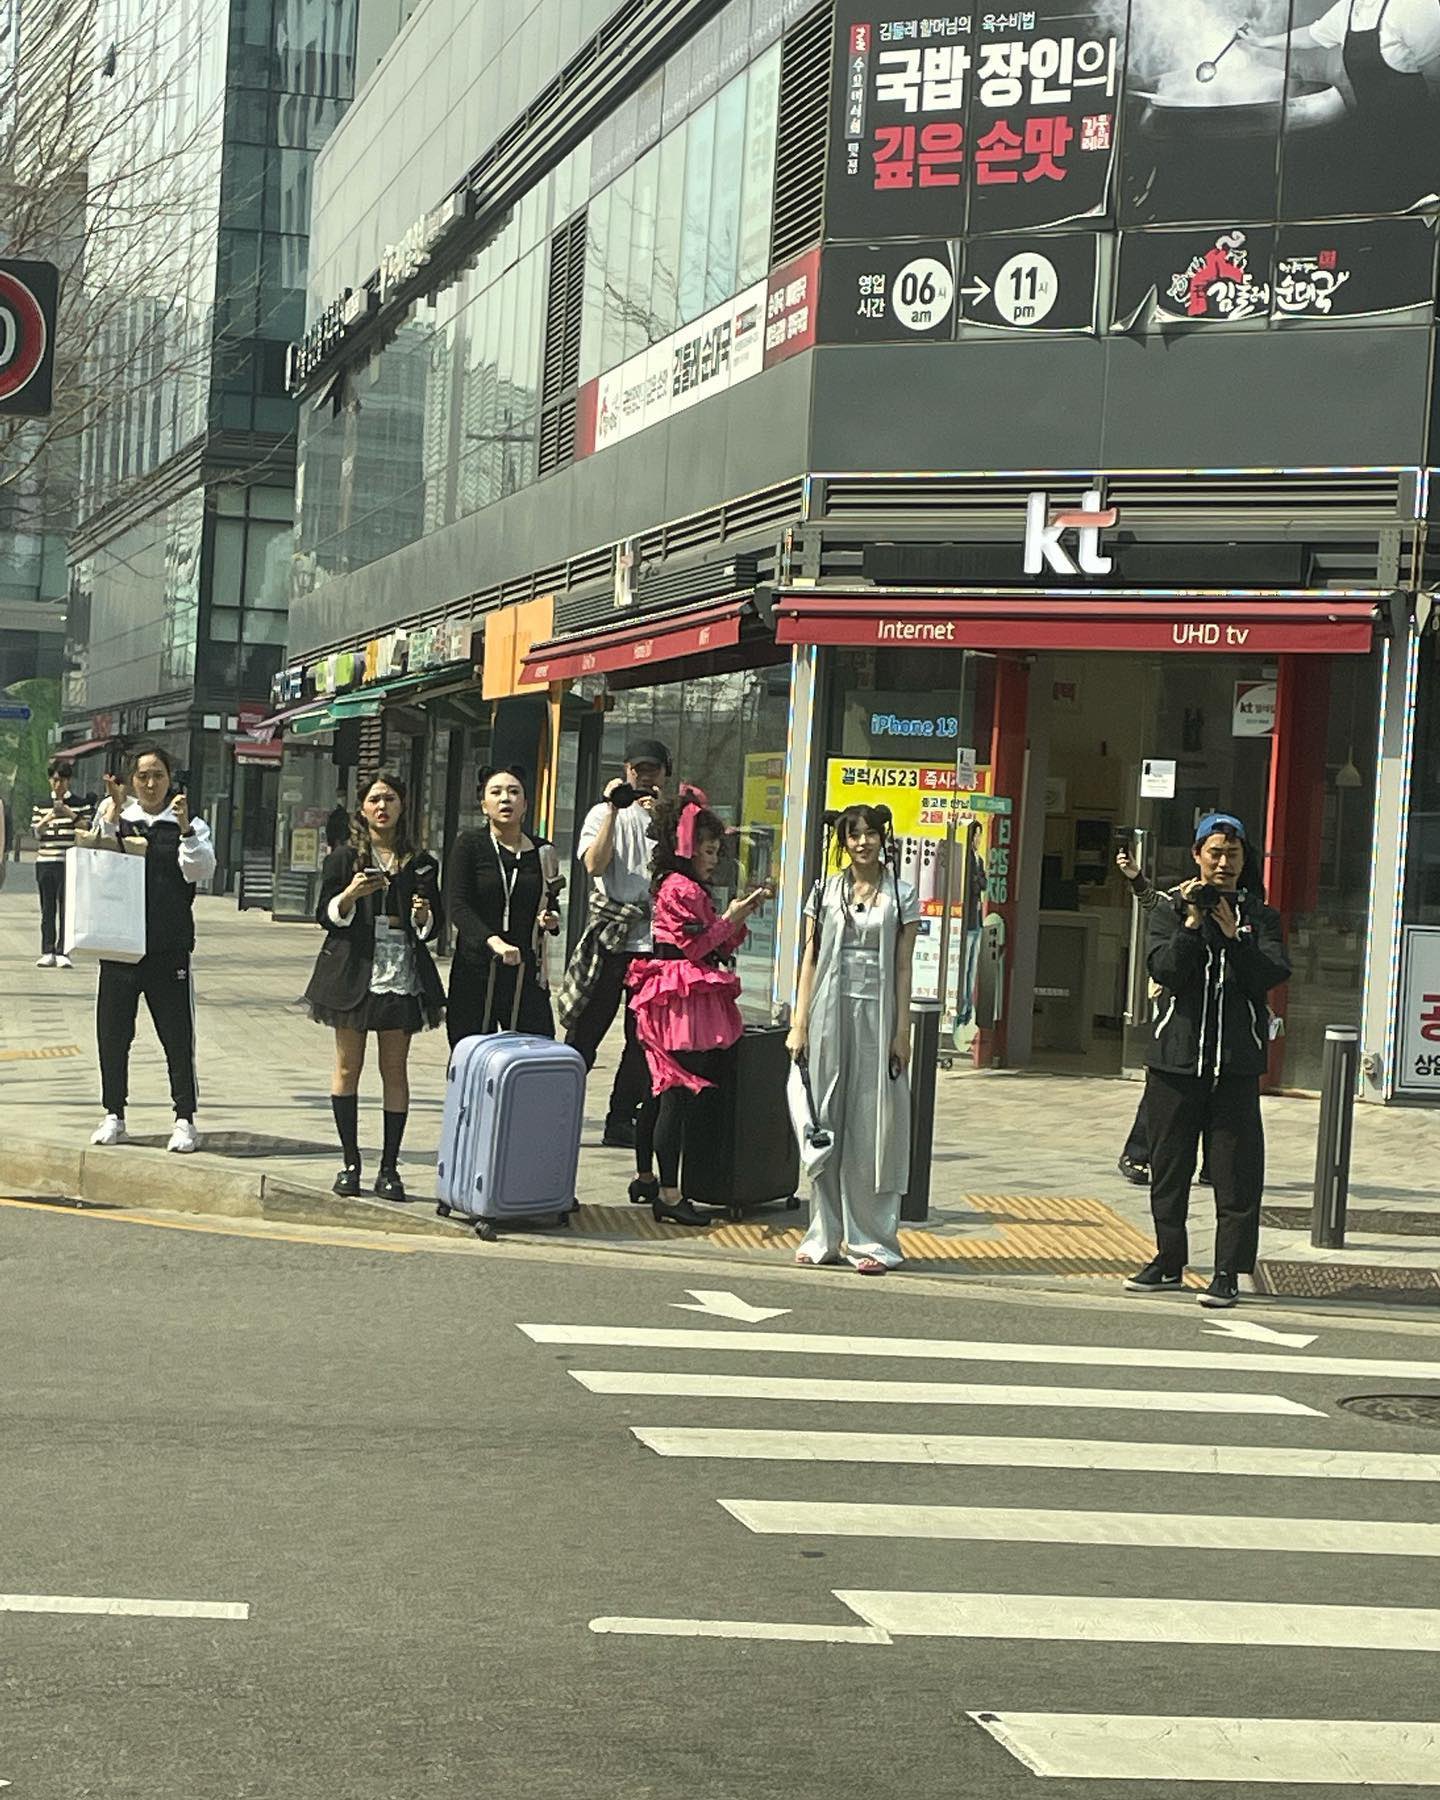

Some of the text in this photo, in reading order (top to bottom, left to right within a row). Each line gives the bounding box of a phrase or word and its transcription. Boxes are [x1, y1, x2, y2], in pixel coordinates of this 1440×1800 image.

[875, 36, 1118, 113] 국밥 장인의
[872, 115, 1074, 190] 깊은 손맛
[858, 274, 886, 296] 영업
[857, 297, 885, 318] 시간
[911, 309, 932, 323] am
[1013, 305, 1036, 320] pm
[1023, 491, 1118, 576] kt
[878, 620, 955, 640] Internet
[1173, 623, 1249, 645] UHD tv
[1240, 702, 1253, 714] kt
[871, 713, 959, 738] iPhone 13
